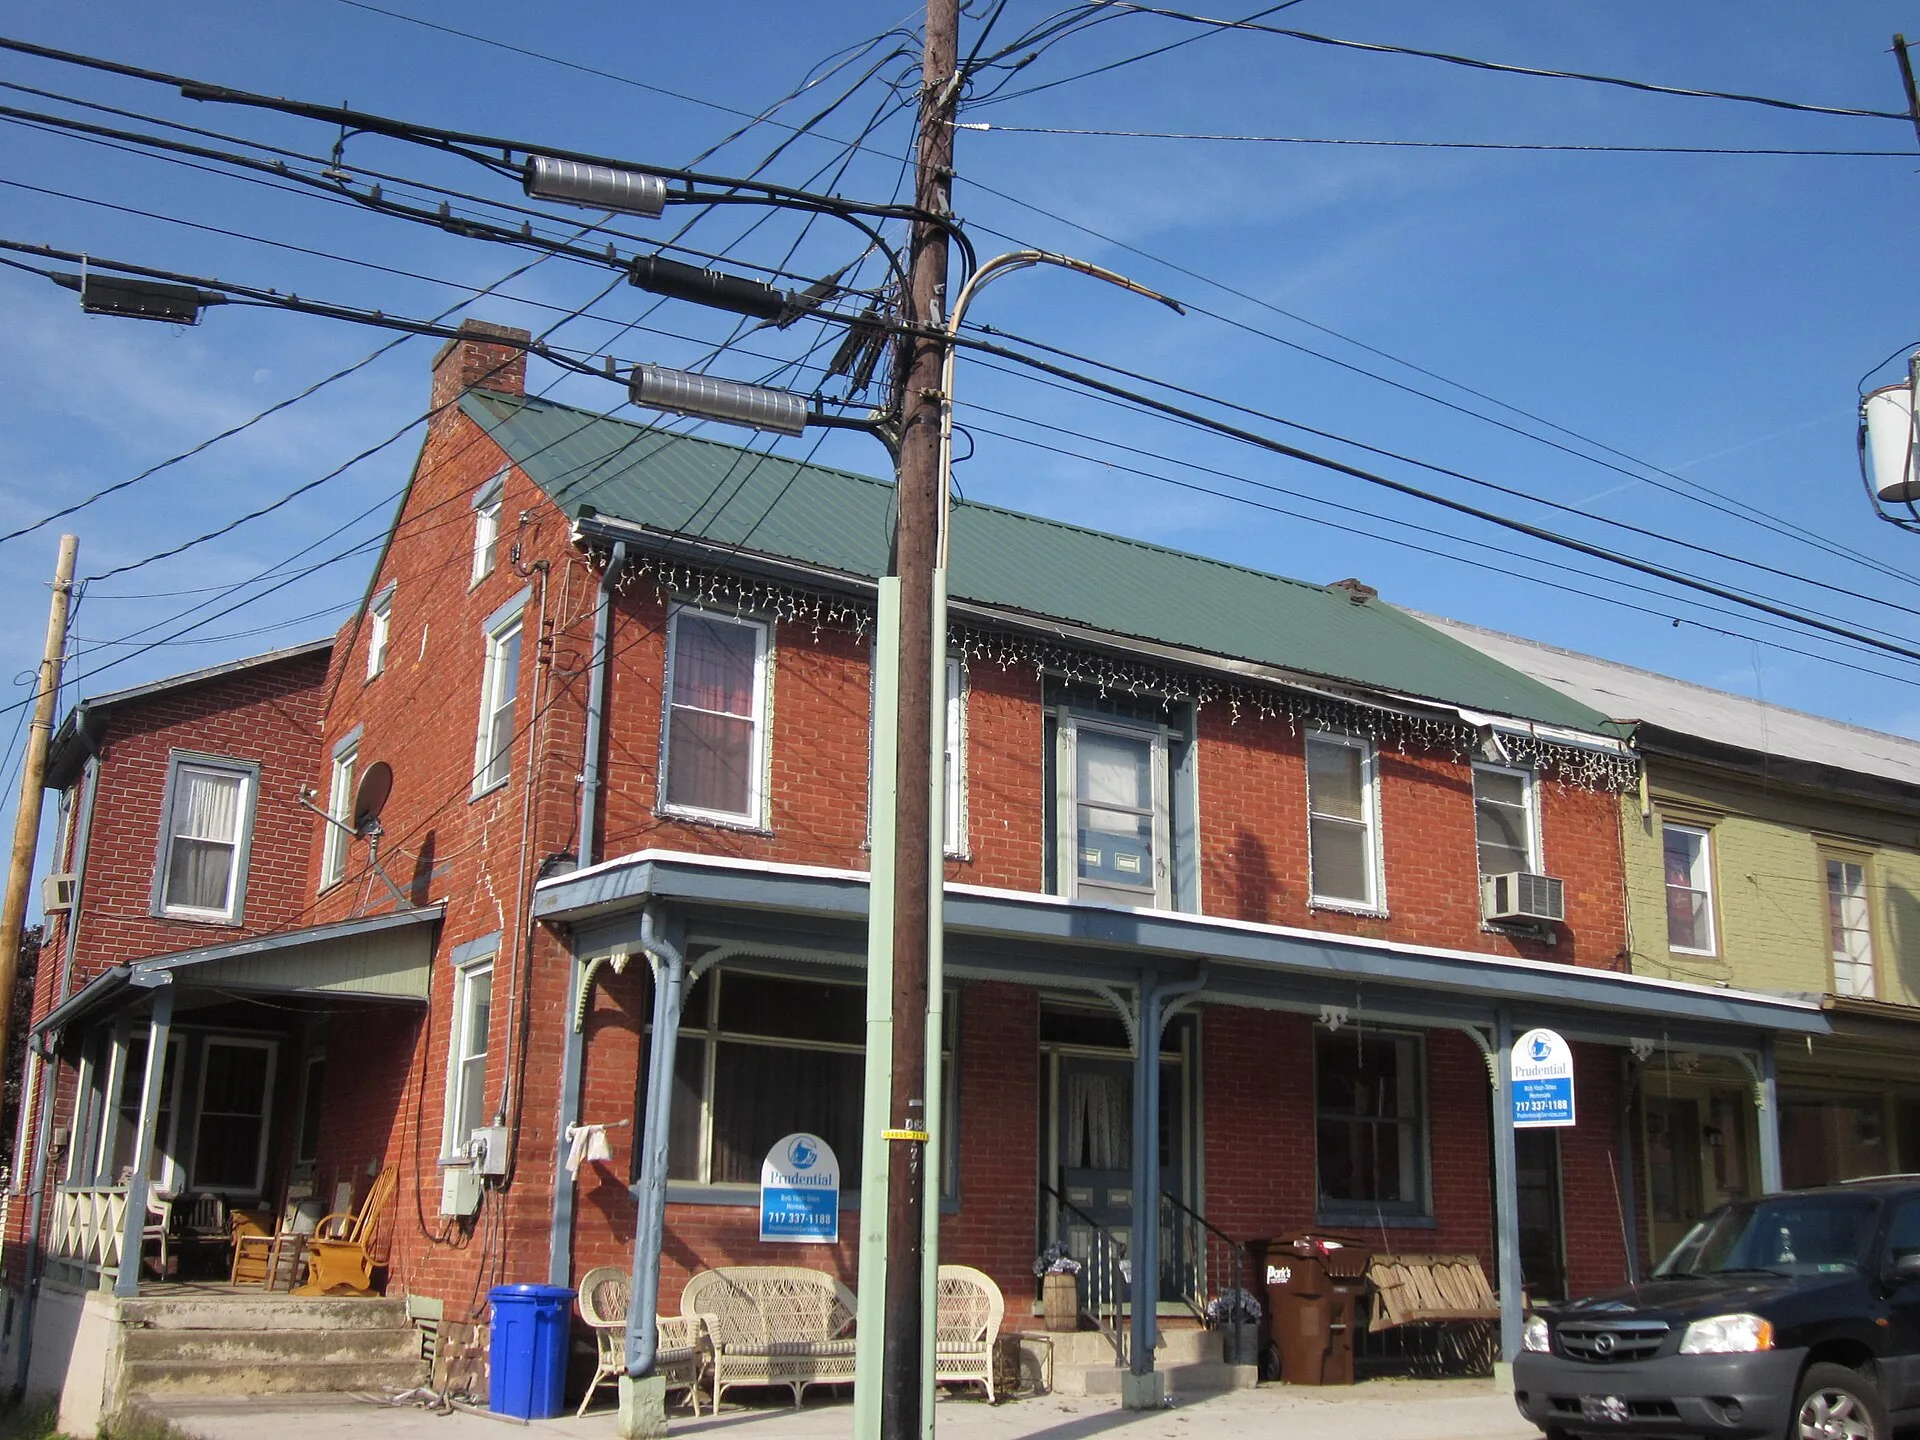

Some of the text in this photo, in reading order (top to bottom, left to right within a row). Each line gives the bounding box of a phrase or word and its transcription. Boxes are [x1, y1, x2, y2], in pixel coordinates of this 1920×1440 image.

[1515, 1063, 1566, 1077] Prudential
[1516, 1102, 1530, 1111] 717
[770, 1172, 832, 1186] Prudential
[768, 1212, 831, 1225] 717 337-1188
[1266, 1265, 1291, 1285] Park's
